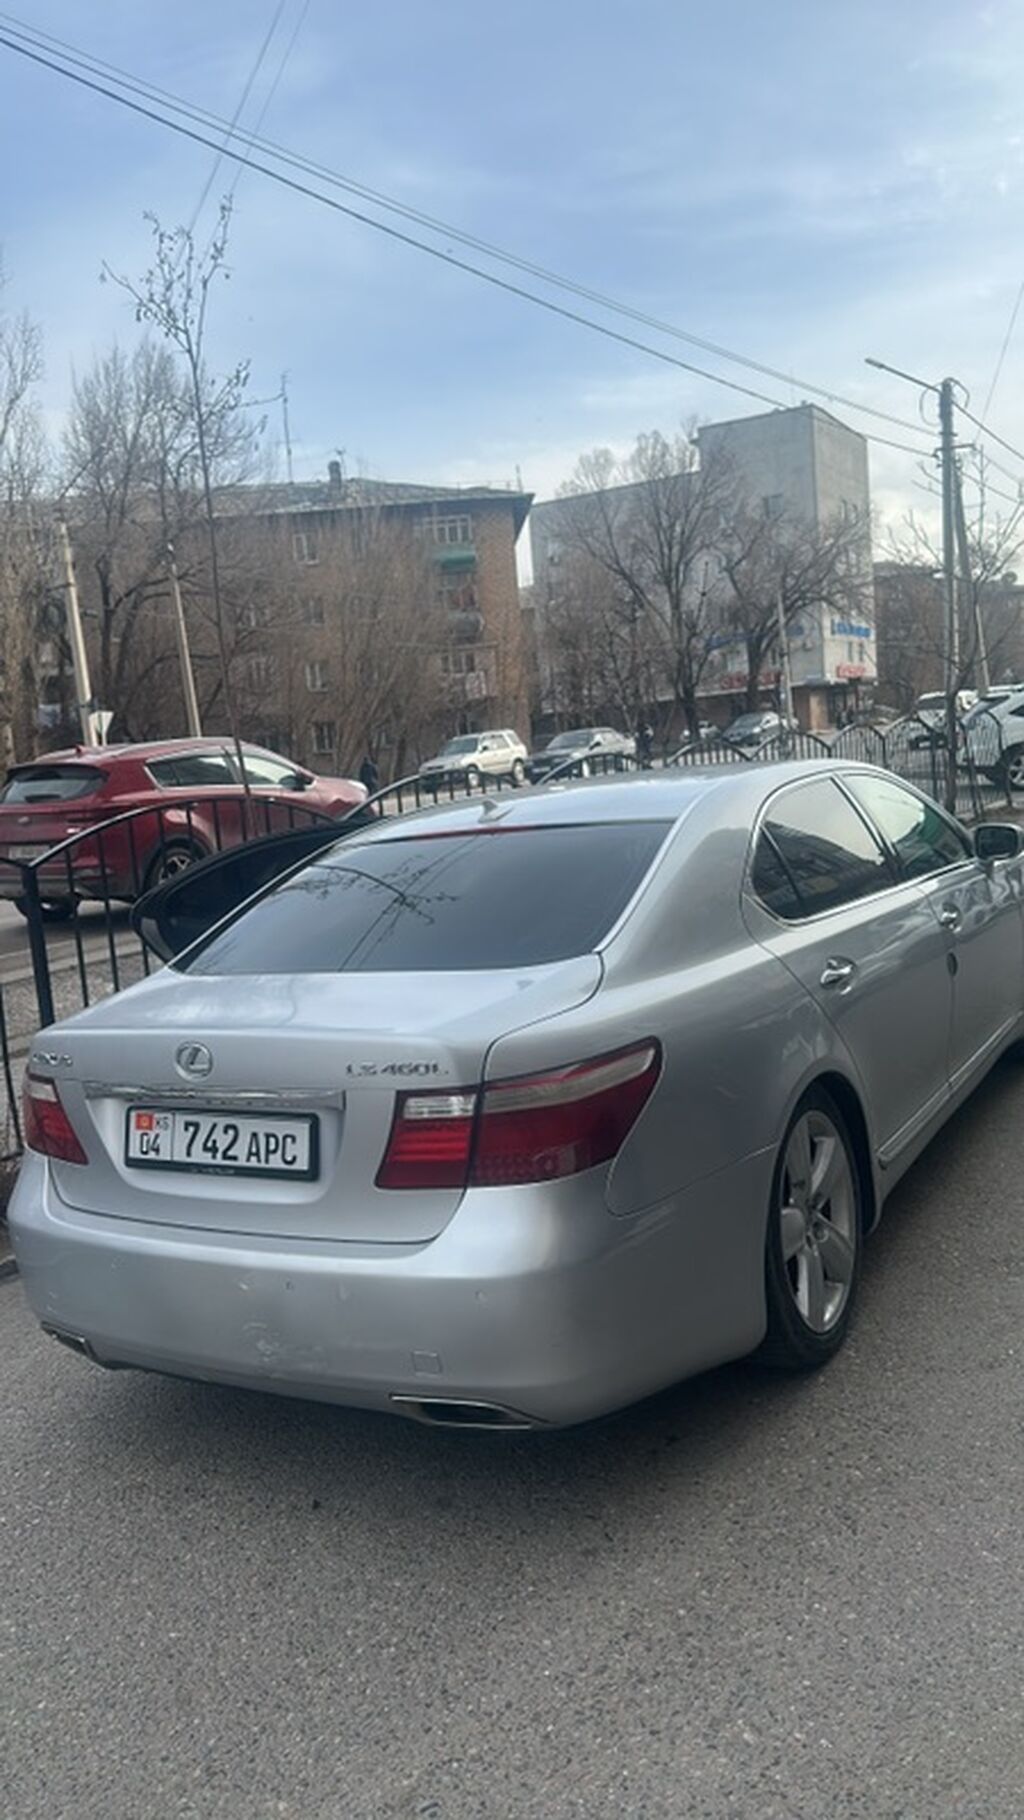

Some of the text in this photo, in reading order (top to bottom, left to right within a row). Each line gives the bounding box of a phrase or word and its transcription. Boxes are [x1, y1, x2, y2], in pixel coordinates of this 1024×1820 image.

[139, 1132, 161, 1156] 04
[183, 1121, 297, 1166] 742 APC
